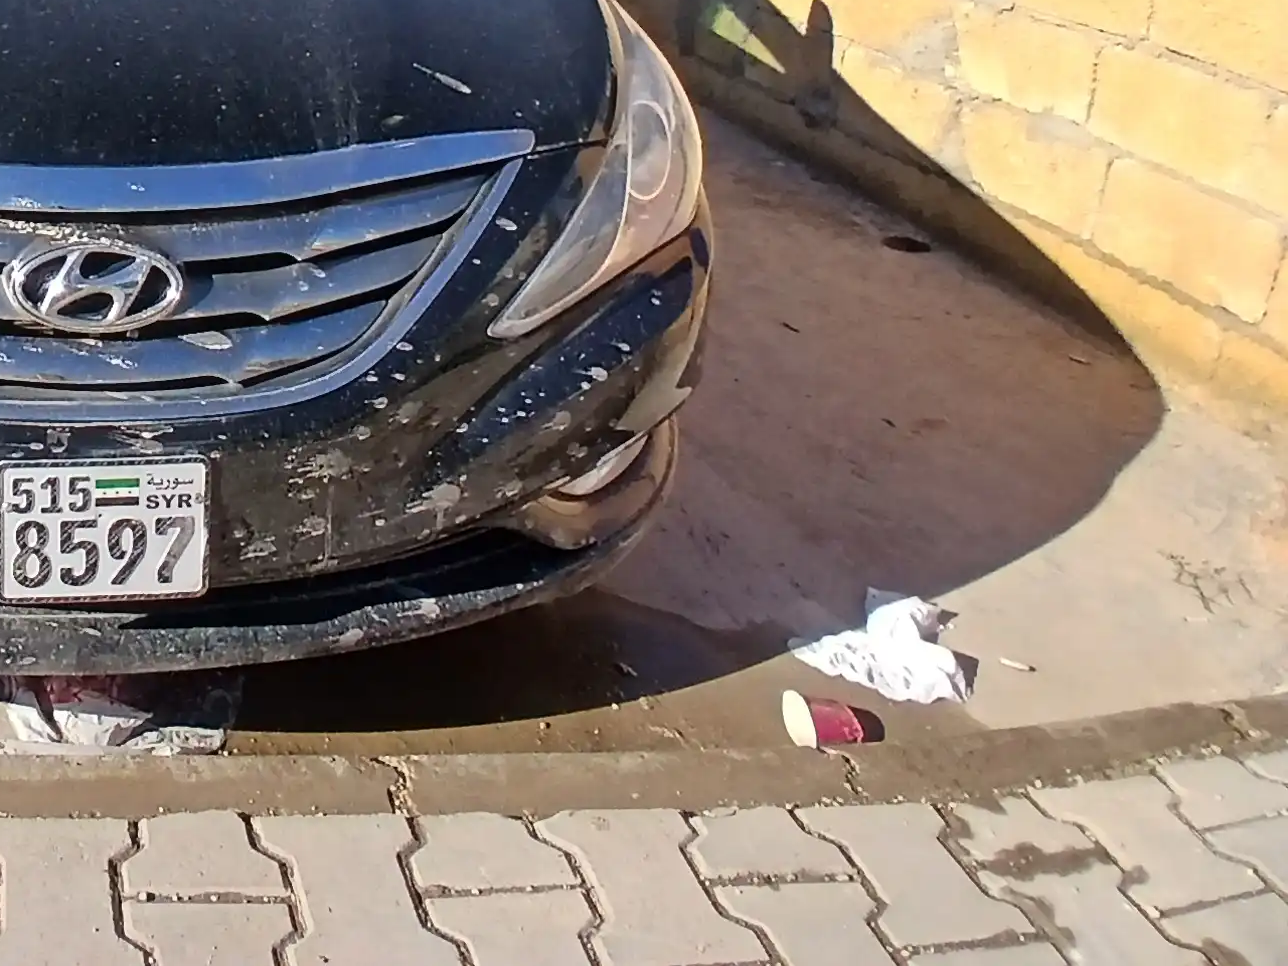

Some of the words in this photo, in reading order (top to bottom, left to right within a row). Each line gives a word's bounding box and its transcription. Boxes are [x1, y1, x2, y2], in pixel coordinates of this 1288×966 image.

[11, 476, 93, 514] 515
[146, 473, 194, 491] سورية
[146, 493, 192, 509] SYR
[13, 516, 197, 589] 8597
